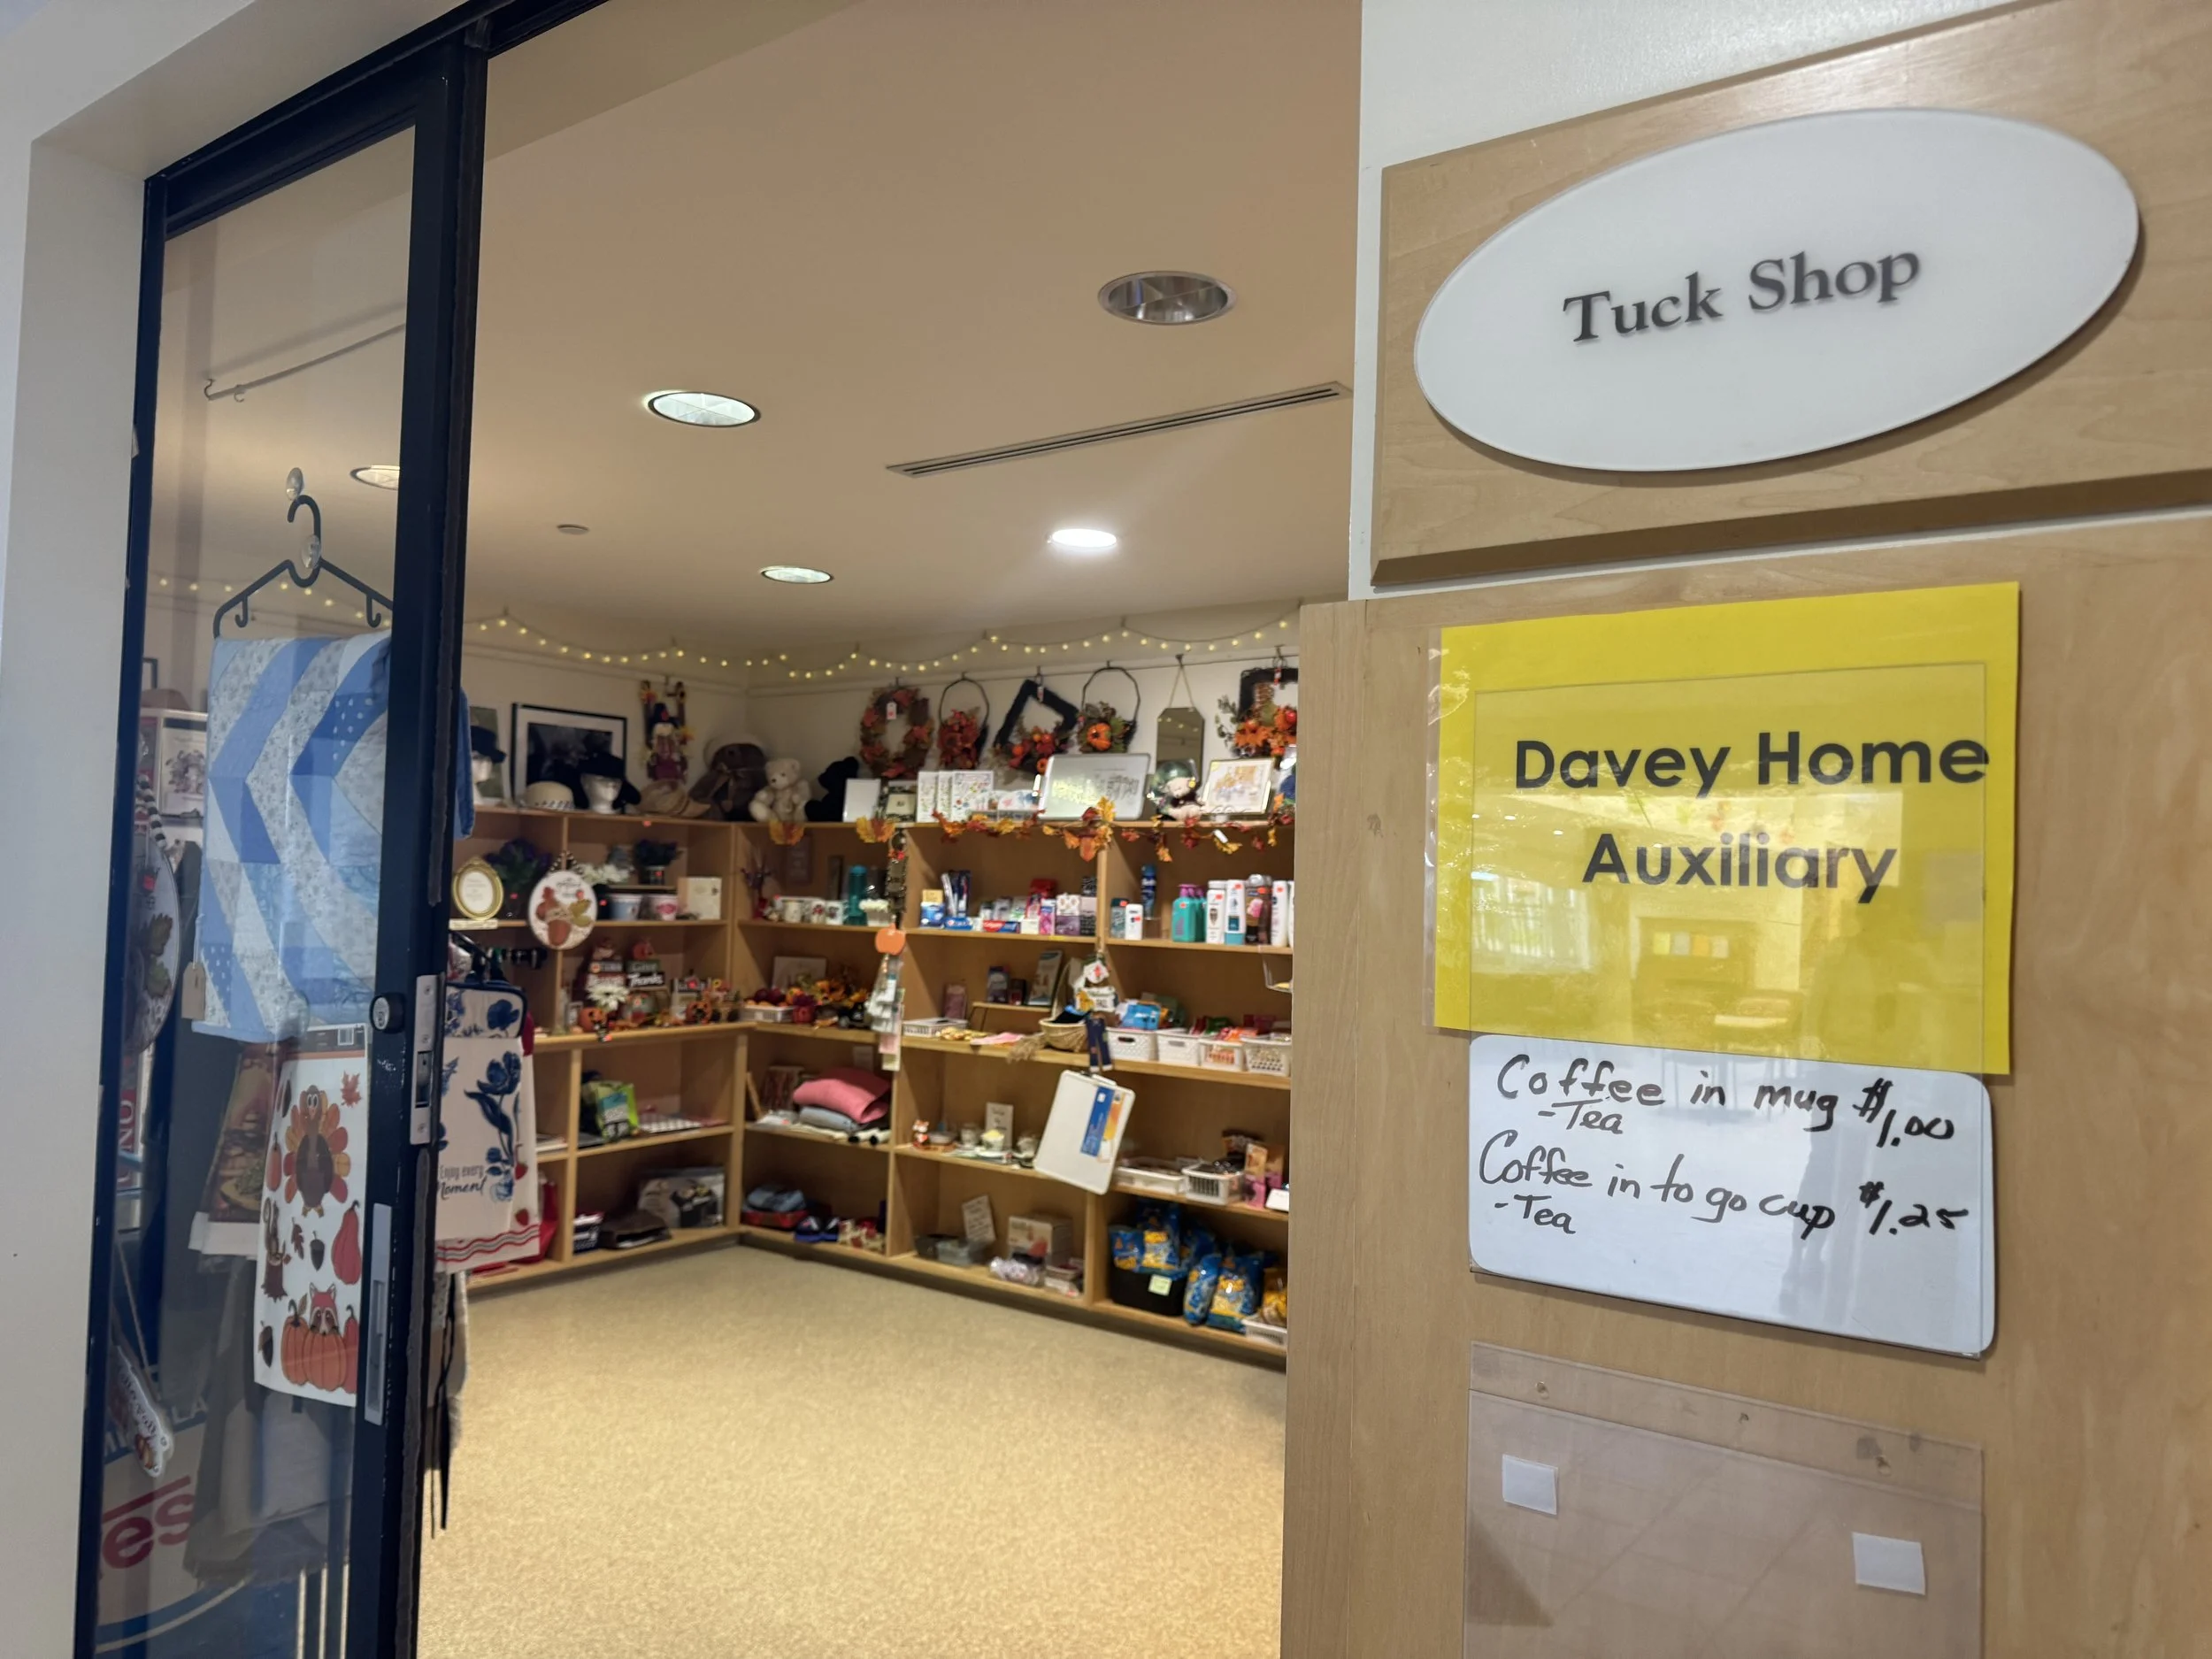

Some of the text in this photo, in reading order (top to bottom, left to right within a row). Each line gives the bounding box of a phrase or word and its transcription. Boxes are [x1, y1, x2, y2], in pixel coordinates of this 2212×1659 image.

[1563, 250, 1921, 342] Tuck Shop
[1515, 731, 1991, 798] Davey Home
[1581, 831, 1898, 904] Auxiliary
[1497, 1055, 1955, 1148] Coffee in mug $1.00
[1479, 1130, 1970, 1240] Coffee in to go cup $1.25
